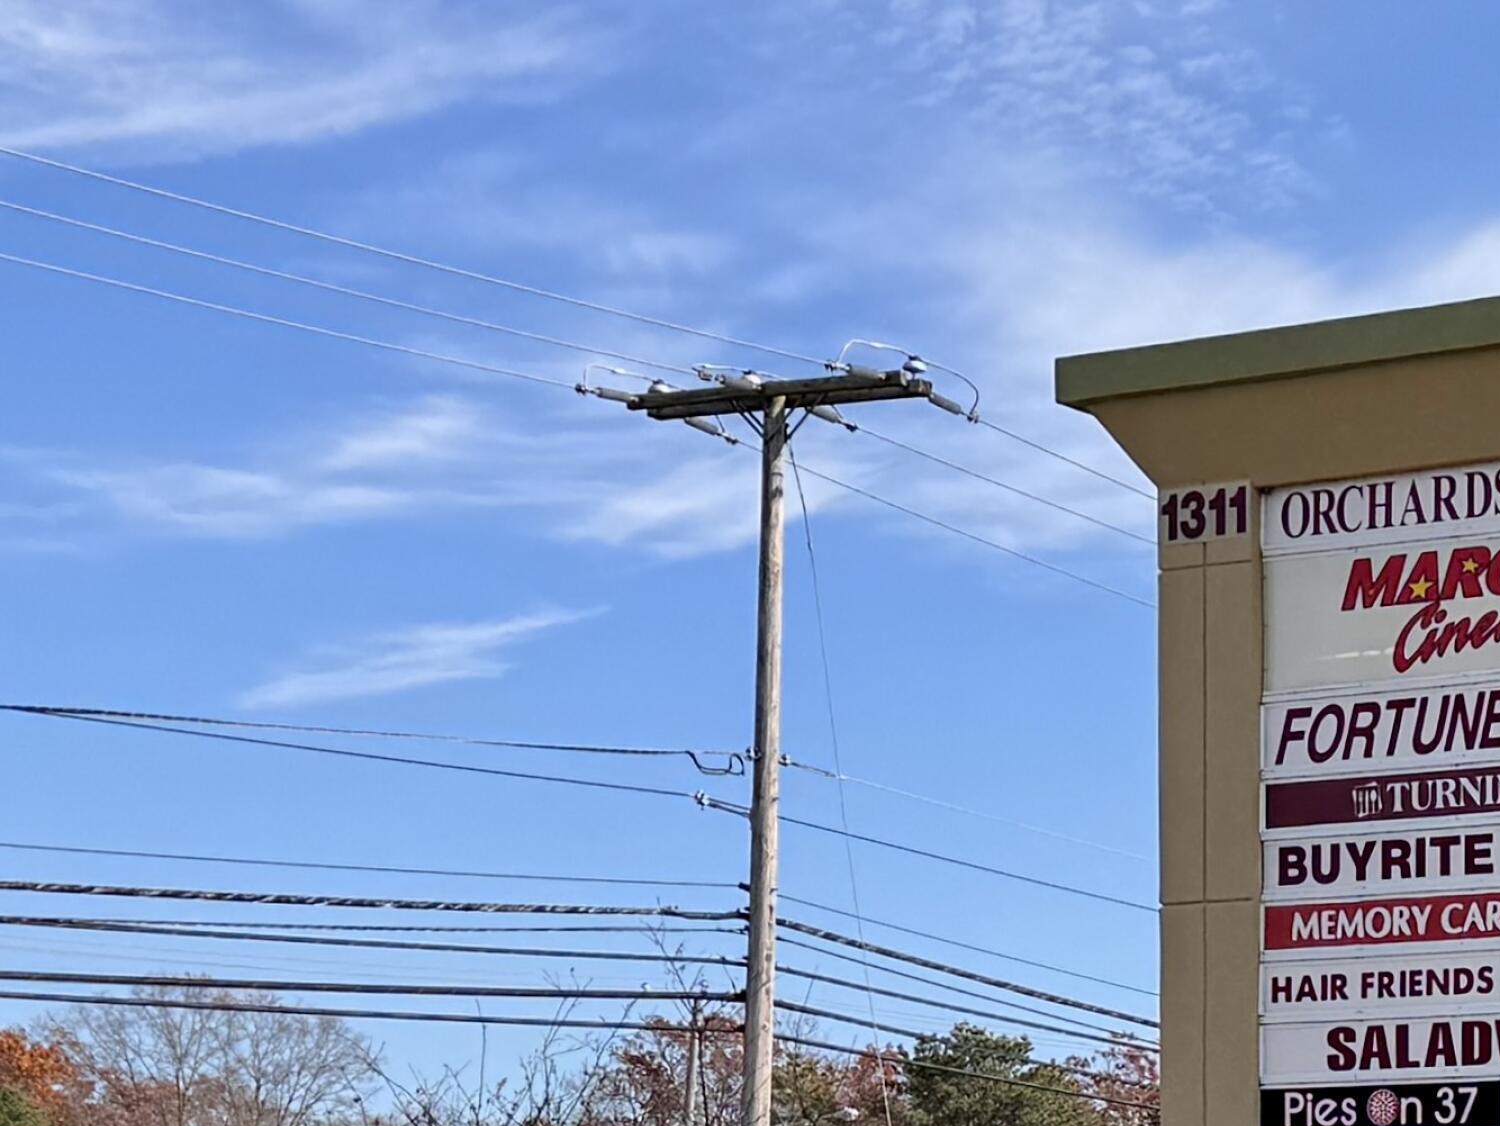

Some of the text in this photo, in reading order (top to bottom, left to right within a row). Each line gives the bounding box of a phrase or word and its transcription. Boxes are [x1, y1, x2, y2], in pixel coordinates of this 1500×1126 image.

[1161, 486, 1249, 541] 1311
[1278, 834, 1494, 887] BUYRITE
[1291, 904, 1431, 942] MEMORY
[1271, 966, 1495, 1003] HAIR FRIENDS
[1434, 1086, 1478, 1125] 37
